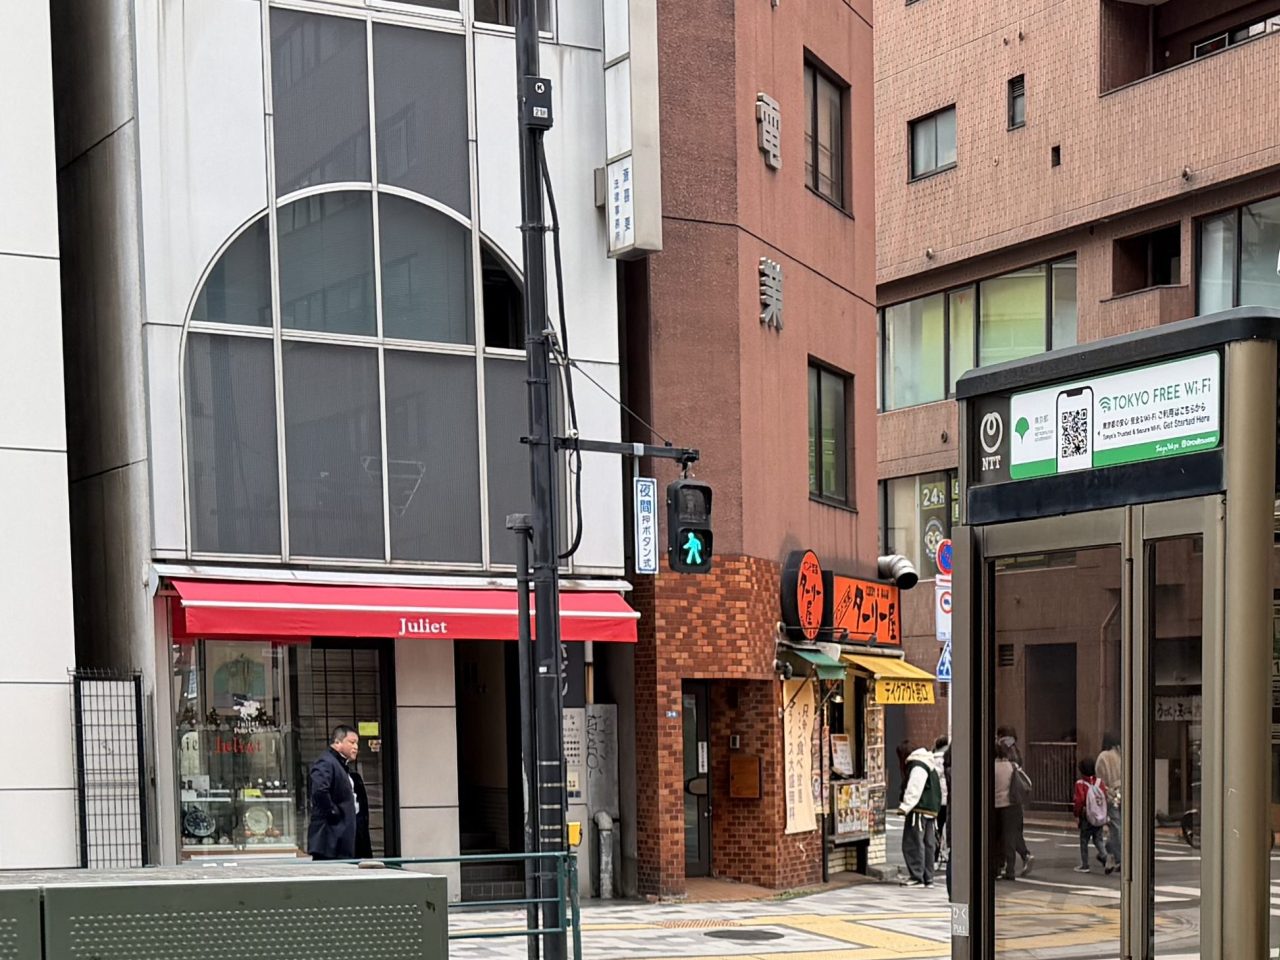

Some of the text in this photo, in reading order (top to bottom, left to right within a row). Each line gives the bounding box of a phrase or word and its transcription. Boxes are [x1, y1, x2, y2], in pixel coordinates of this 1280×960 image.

[1113, 377, 1211, 411] TOKYO FREE Wi-Fi
[981, 456, 1001, 472] NTT
[922, 487, 945, 507] 24h
[639, 483, 652, 568] 夜間押ボタン式
[399, 617, 448, 635] Juliet
[852, 584, 897, 641] ターリー屋
